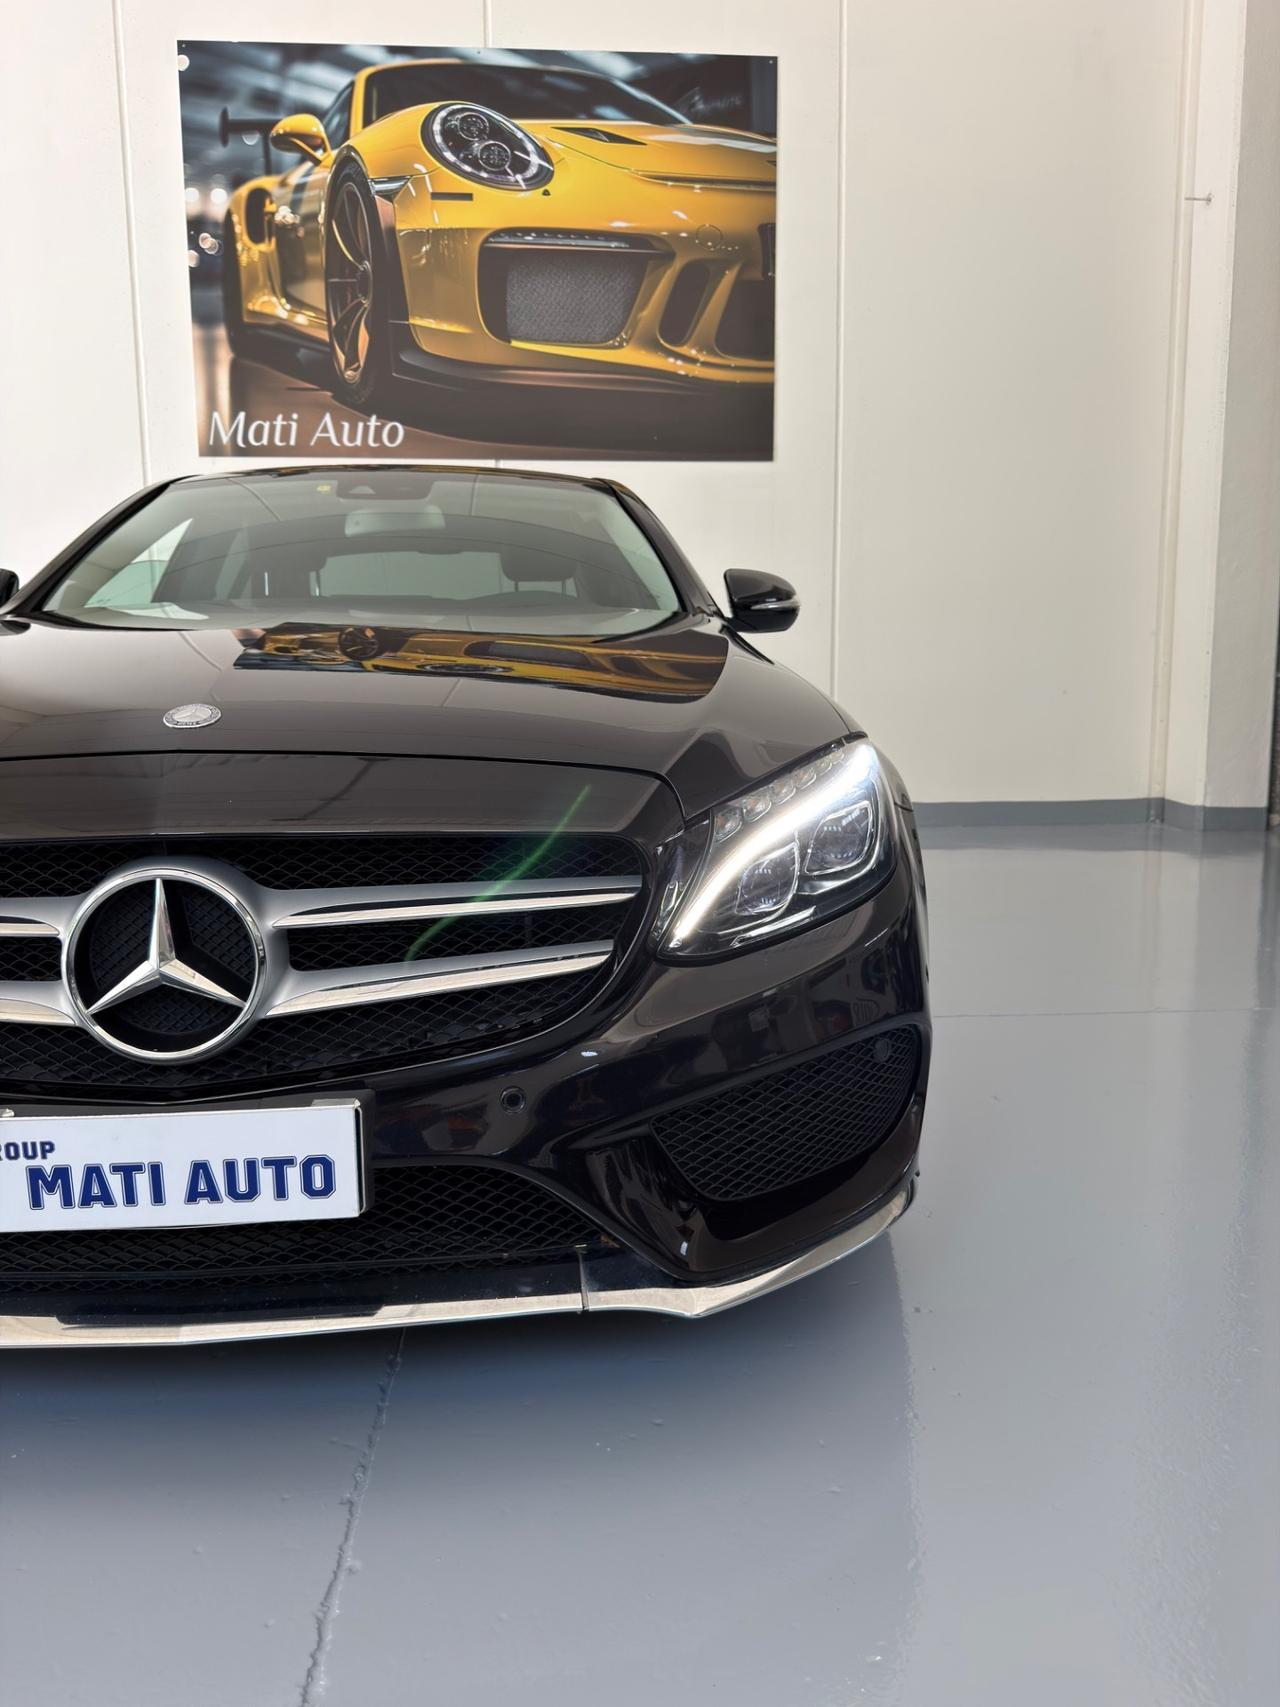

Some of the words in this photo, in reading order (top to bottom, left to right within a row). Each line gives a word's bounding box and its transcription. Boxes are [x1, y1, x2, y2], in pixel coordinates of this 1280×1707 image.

[209, 411, 299, 448] Mati
[310, 412, 405, 448] Auto
[0, 1140, 55, 1161] OUP
[25, 1161, 166, 1210] MATI
[184, 1154, 337, 1204] AUTO
